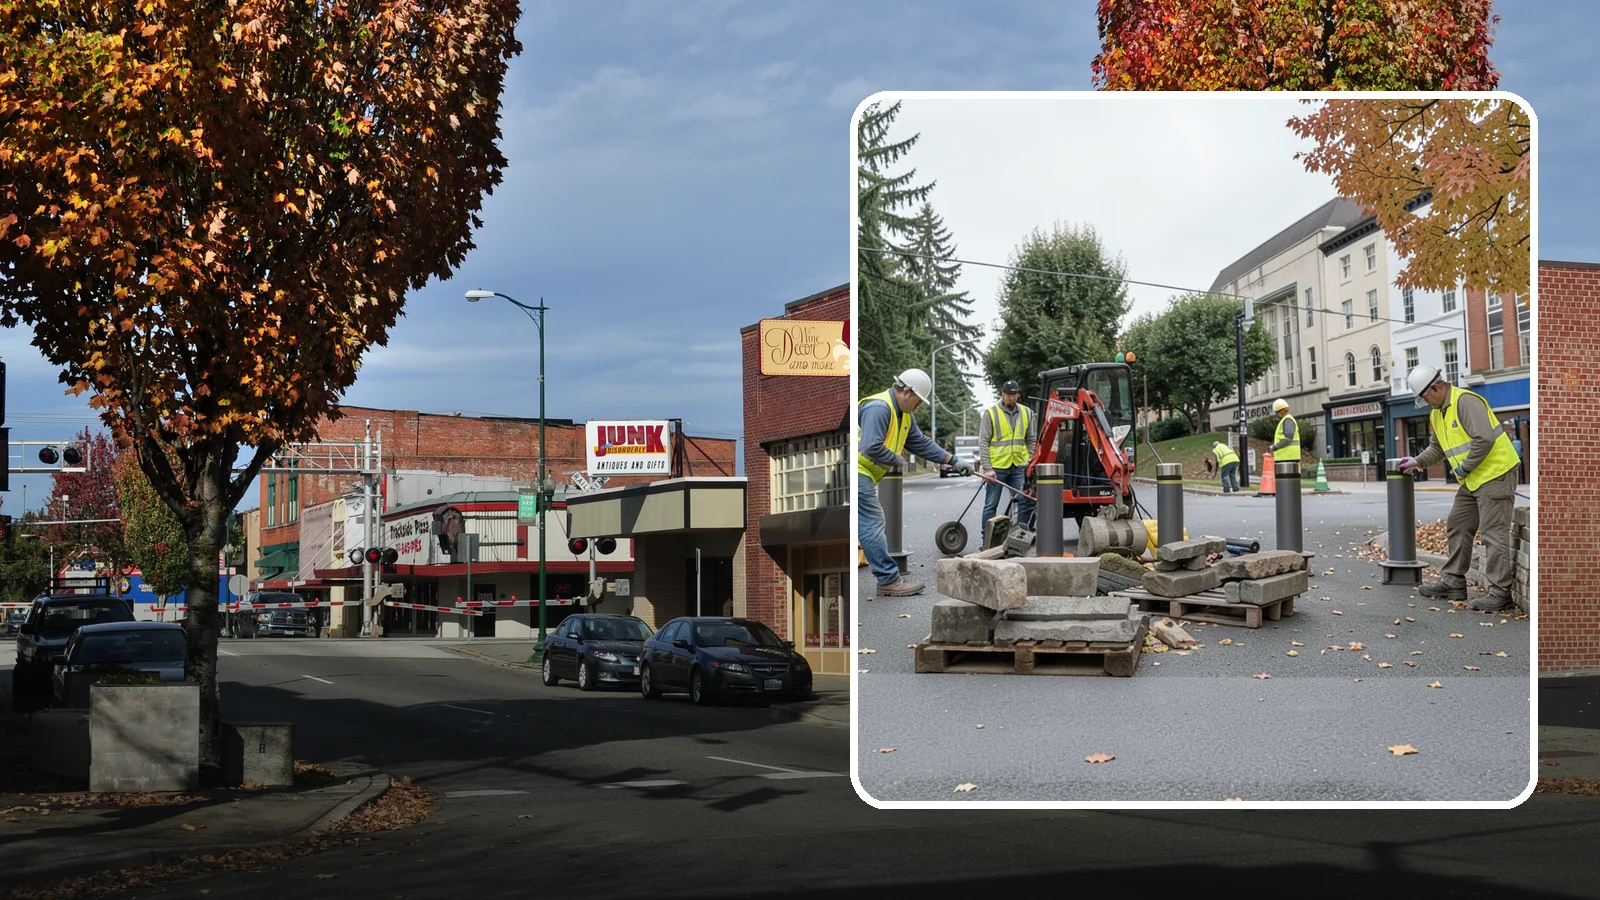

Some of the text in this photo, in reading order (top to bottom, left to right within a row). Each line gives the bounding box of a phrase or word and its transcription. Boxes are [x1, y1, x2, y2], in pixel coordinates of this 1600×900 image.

[765, 328, 831, 365] Decor
[595, 425, 666, 457] JUNK
[607, 446, 646, 454] DISORDERLY
[597, 460, 665, 470] ANTIQUES AND GIFTS
[352, 498, 365, 511] CRO
[390, 519, 429, 540] Trackside Pizza
